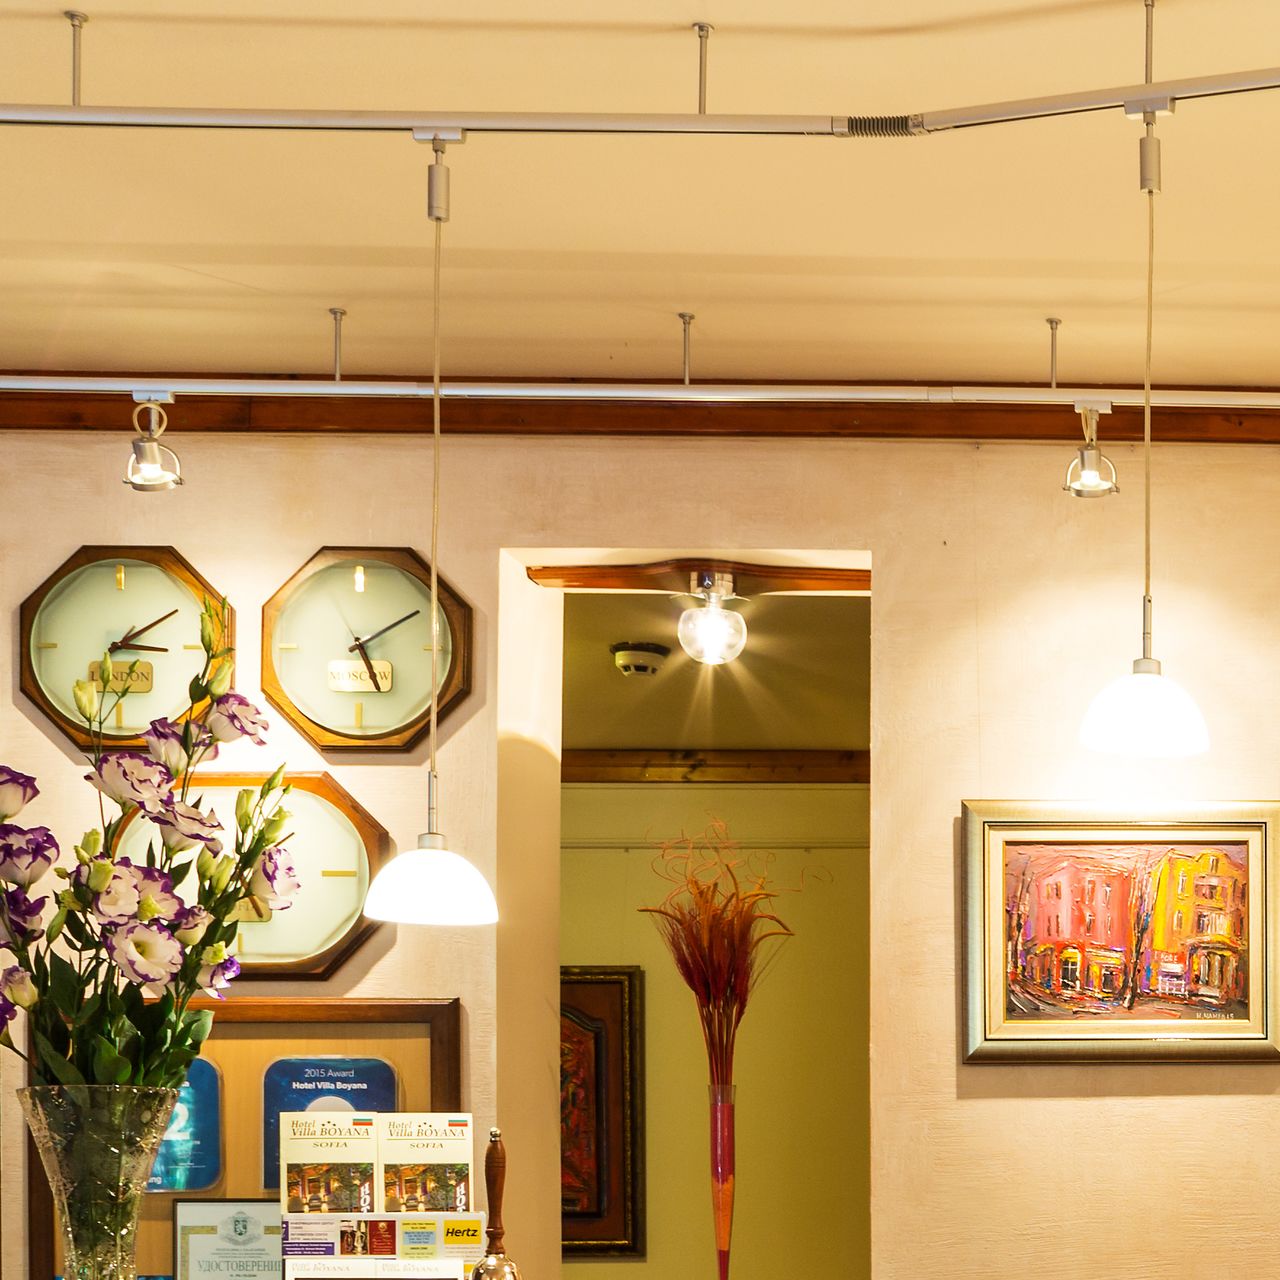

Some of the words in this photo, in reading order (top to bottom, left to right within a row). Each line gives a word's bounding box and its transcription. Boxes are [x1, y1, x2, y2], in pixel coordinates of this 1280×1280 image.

[90, 671, 150, 682] LNDON
[329, 671, 390, 681] MOSCW
[304, 1068, 326, 1078] 2015
[327, 1068, 355, 1078] Award
[292, 1081, 316, 1090] Hotel
[316, 1081, 335, 1090] Villa
[336, 1081, 368, 1091] Boyana
[291, 1119, 316, 1128] Hotel
[388, 1121, 412, 1129] Hotel
[292, 1128, 317, 1137] Villa
[320, 1127, 370, 1137] BOYANA
[388, 1128, 413, 1137] Villa
[416, 1128, 465, 1137] BOYANA
[312, 1141, 348, 1149] SOFIA
[446, 1227, 478, 1238] Hertz
